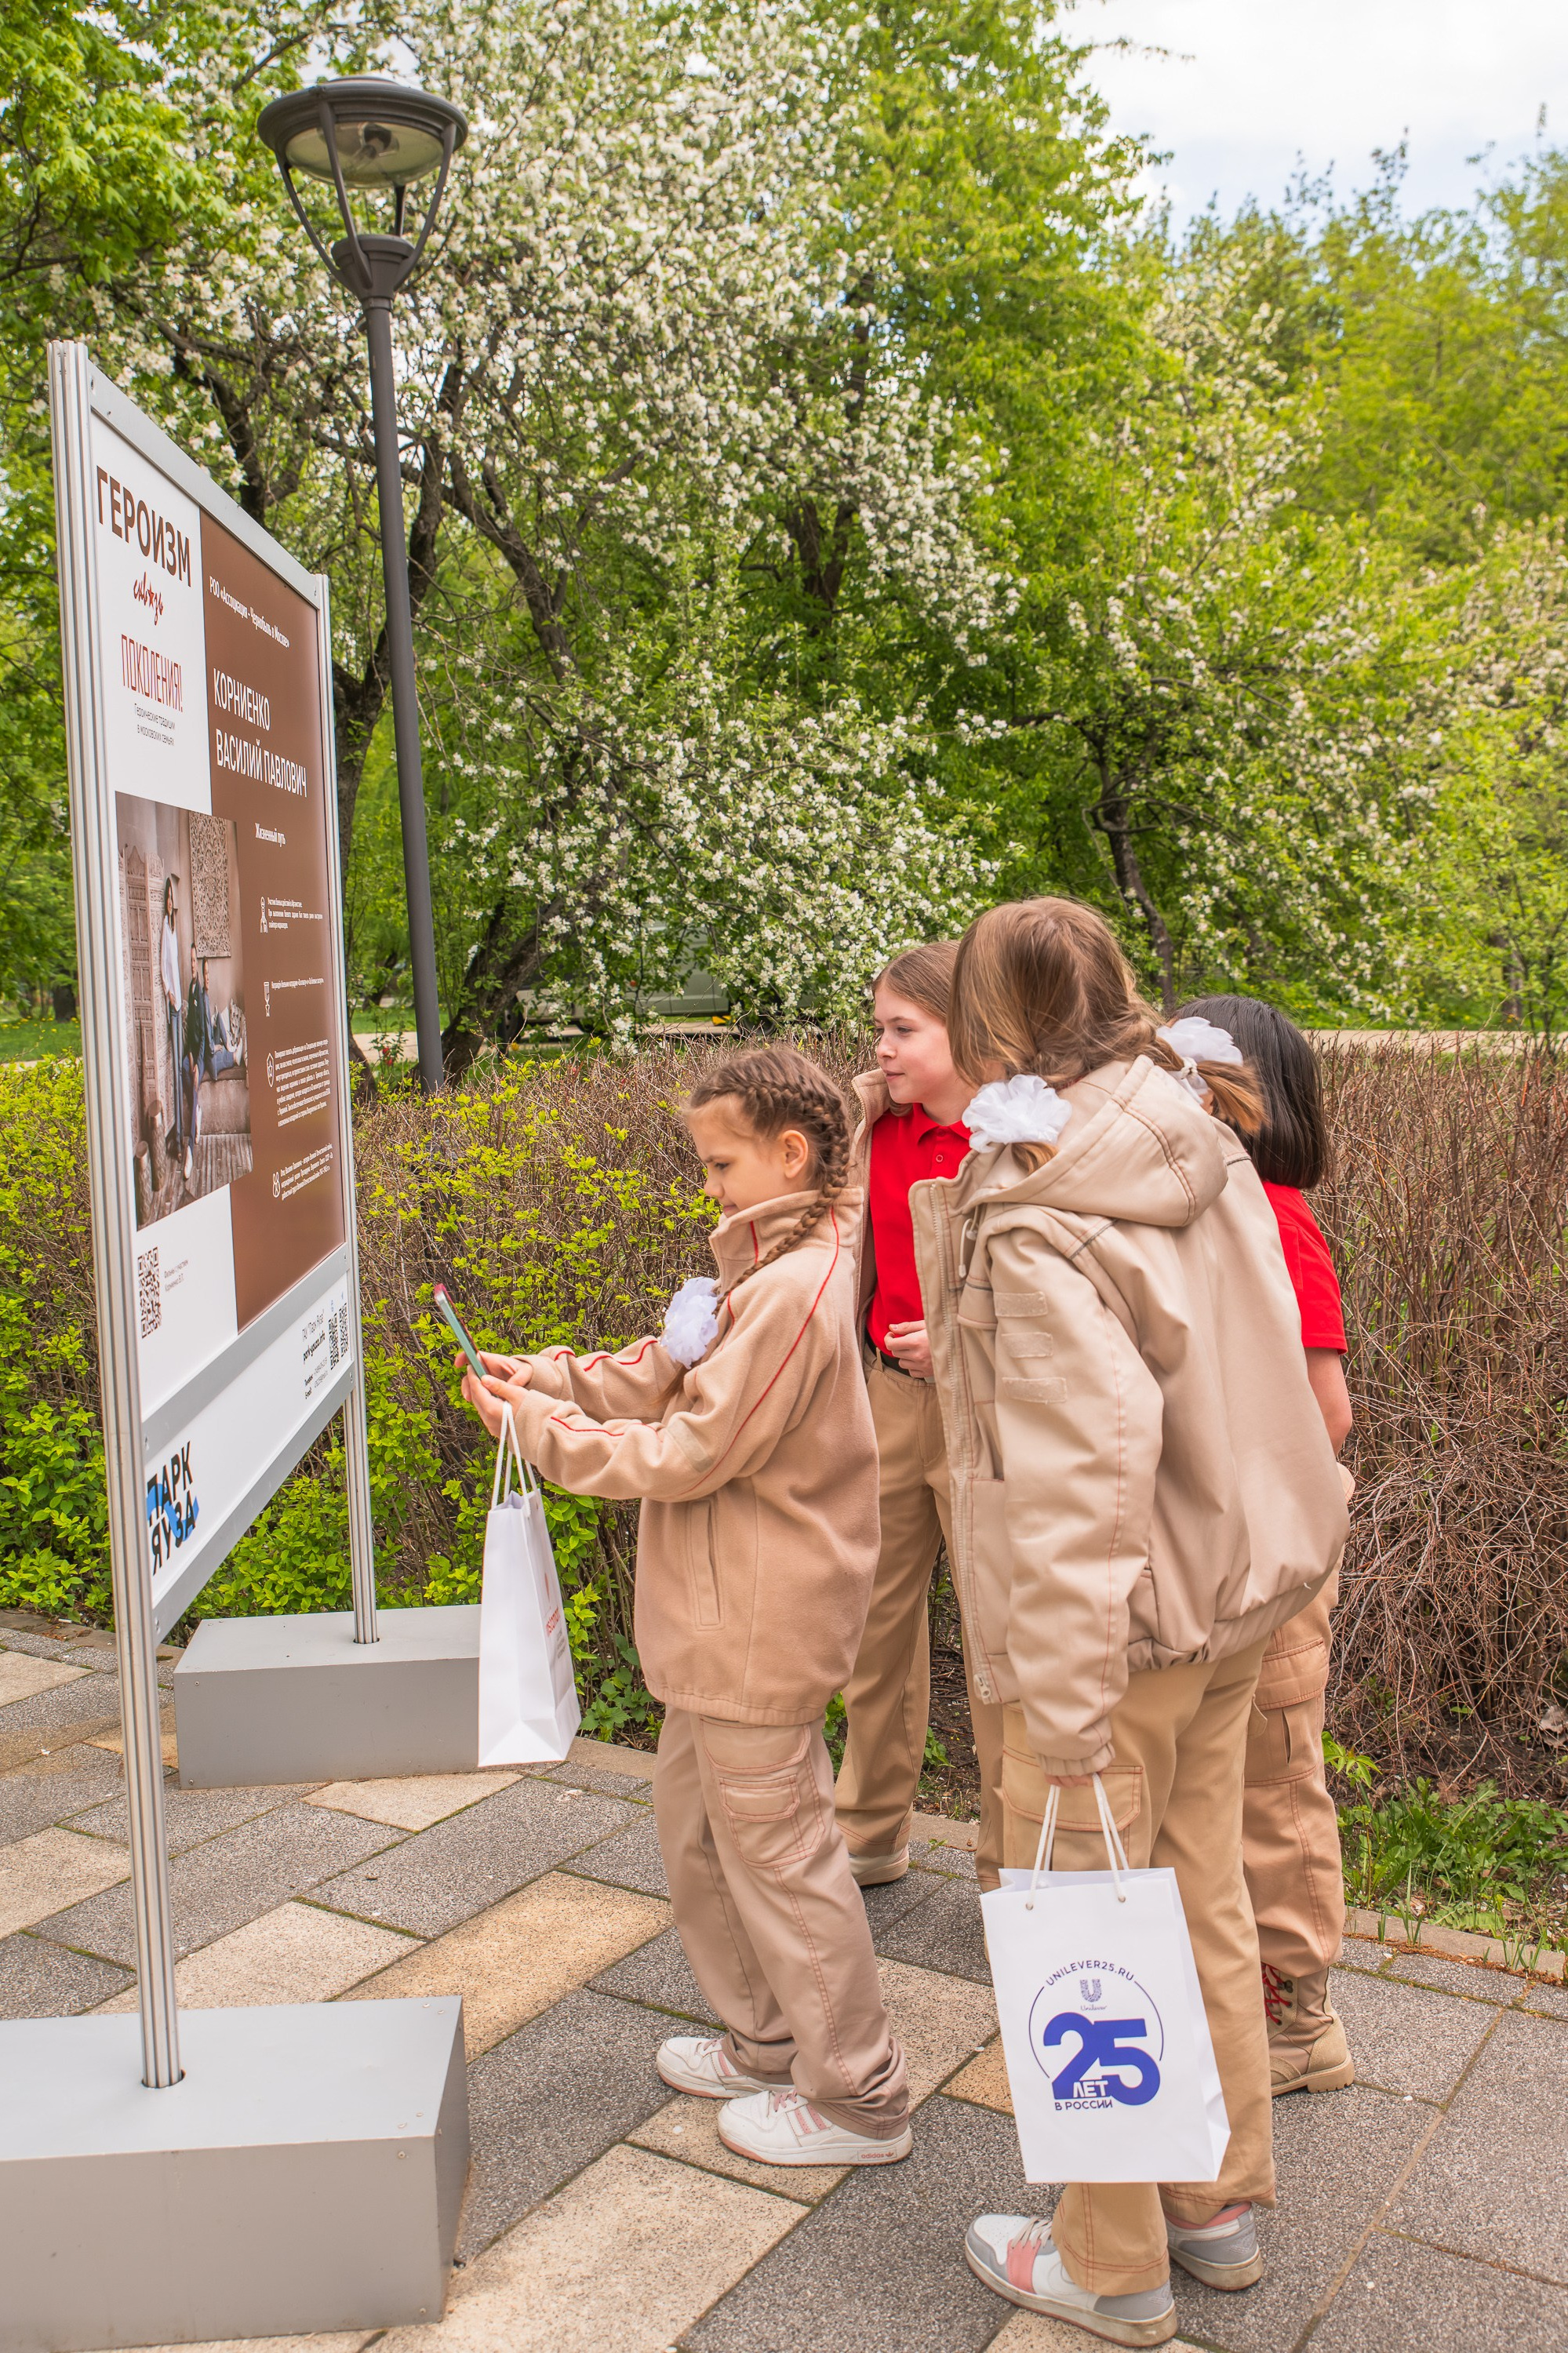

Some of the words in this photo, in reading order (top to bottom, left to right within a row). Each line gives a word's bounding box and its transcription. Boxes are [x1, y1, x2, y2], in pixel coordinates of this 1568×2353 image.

[96, 465, 191, 587] ГЕРОИЗМ
[209, 576, 220, 598] РОО
[122, 634, 183, 712] ПОКОЛЕНИЯ!
[213, 667, 271, 731] КОРНИЕНКО
[216, 729, 263, 781] ВАСИЛИЙ
[264, 749, 307, 798] ПАВЛОВИЧ
[147, 1440, 193, 1528] ПАРК
[151, 1489, 196, 1577] ЯУЗА
[1046, 1960, 1134, 1986] UNILEVER25.RU
[1043, 2012, 1161, 2106] 25
[1073, 2080, 1109, 2098] ЛЕТ
[1055, 2102, 1062, 2111] В
[1065, 2100, 1113, 2110] РОССИИ
